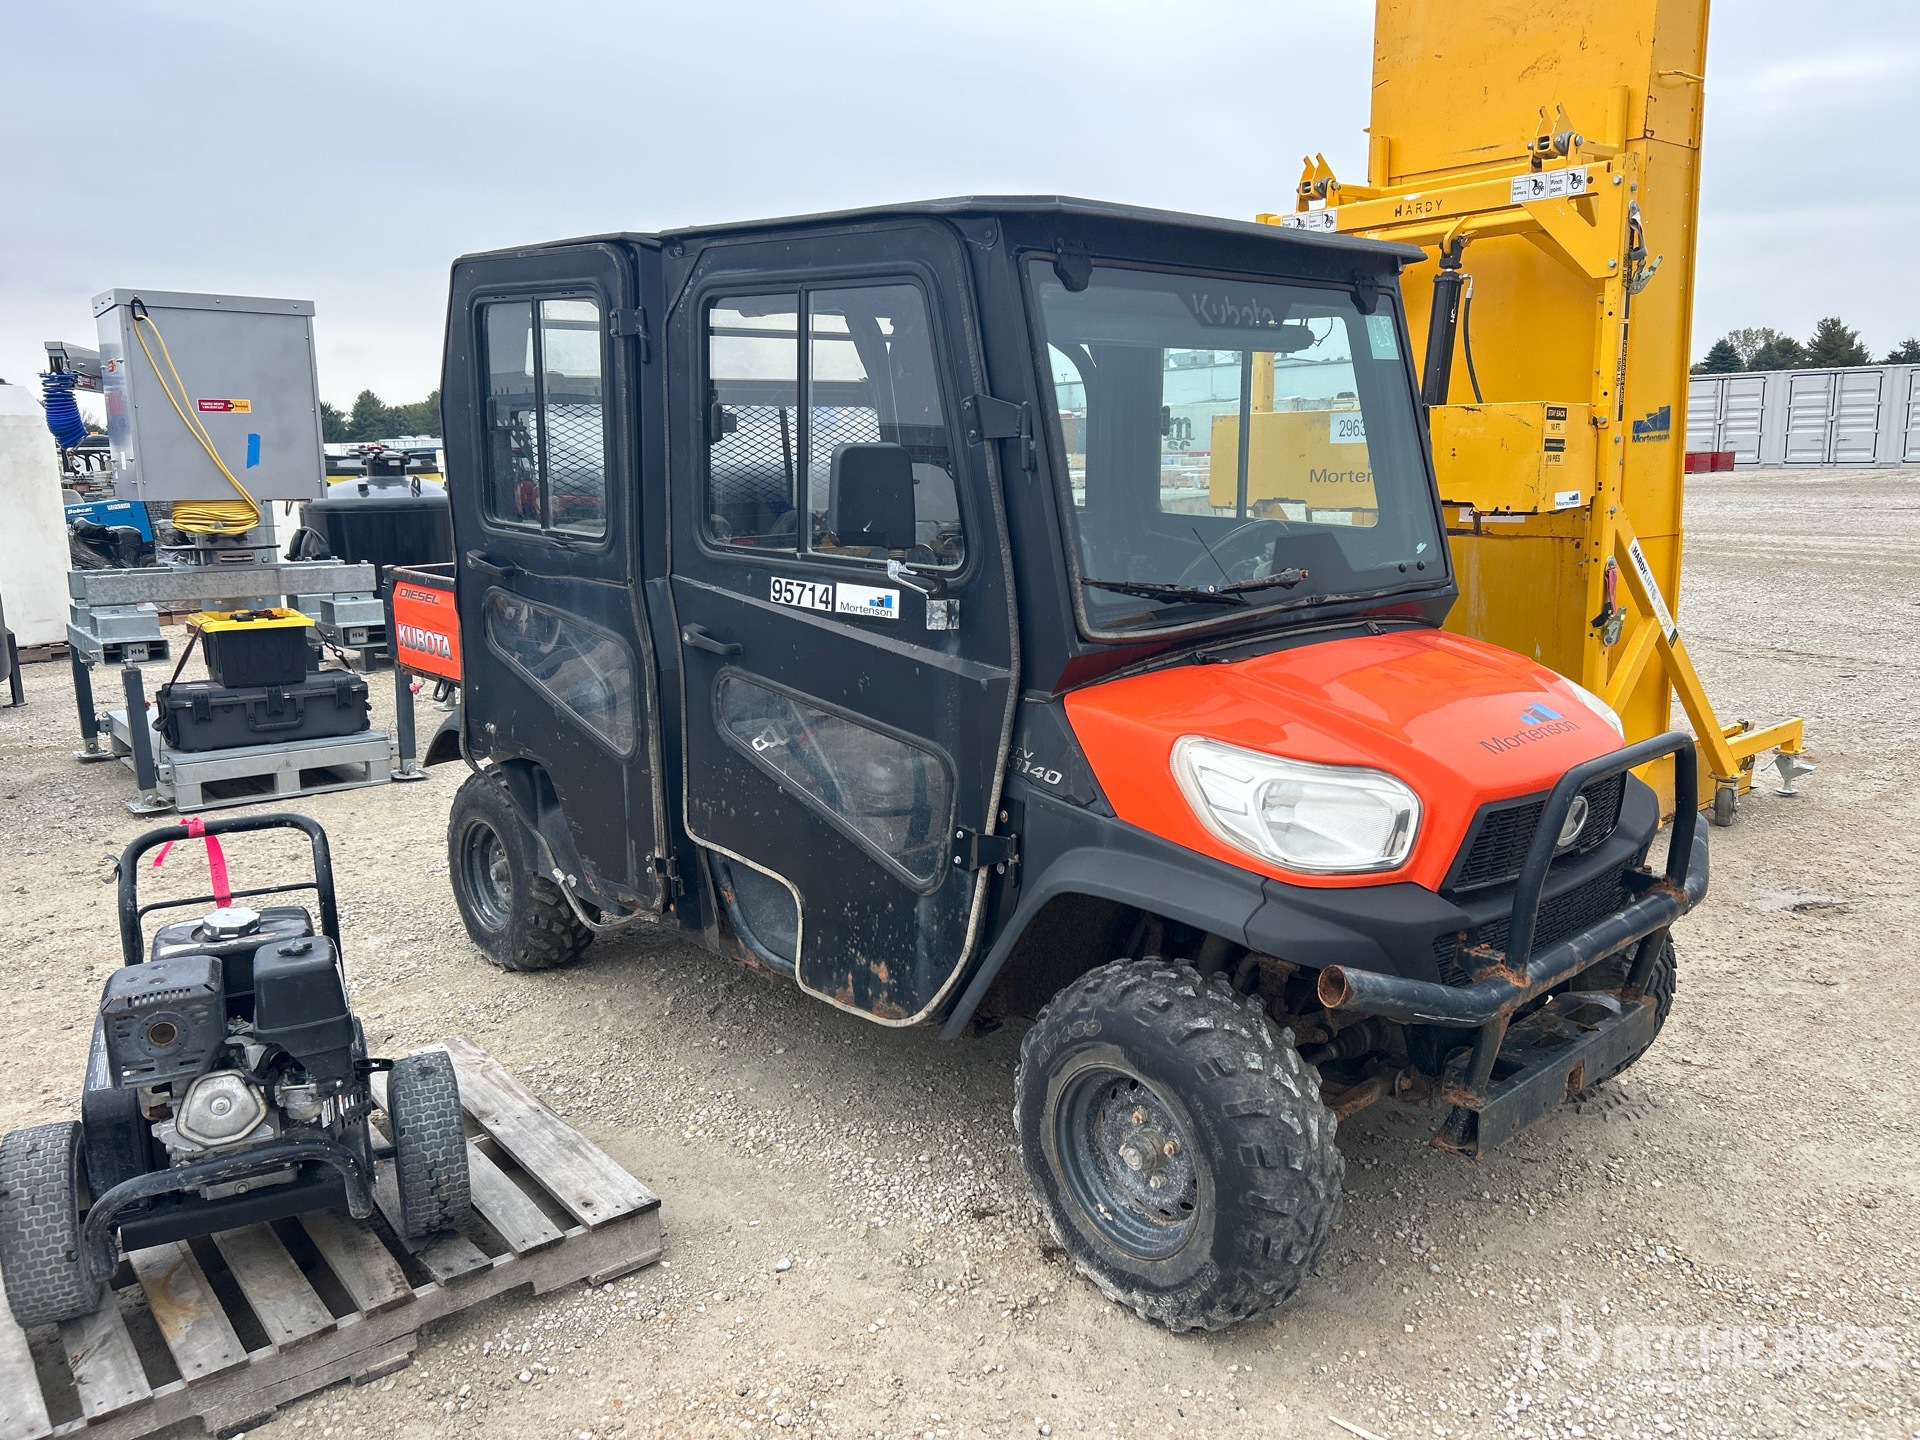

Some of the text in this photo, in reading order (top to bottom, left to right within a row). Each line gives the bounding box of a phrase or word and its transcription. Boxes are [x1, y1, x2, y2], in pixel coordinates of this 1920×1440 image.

[1394, 199, 1443, 218] HARDY
[1192, 293, 1276, 326] Kubota
[1632, 433, 1670, 443] Mortenson
[67, 506, 93, 515] Bobcat
[399, 588, 440, 605] DIESEL
[772, 579, 894, 618] 95714 Mortenson
[131, 647, 145, 655] HM
[397, 623, 453, 661] KUBOTA
[1479, 719, 1581, 756] Mortenson
